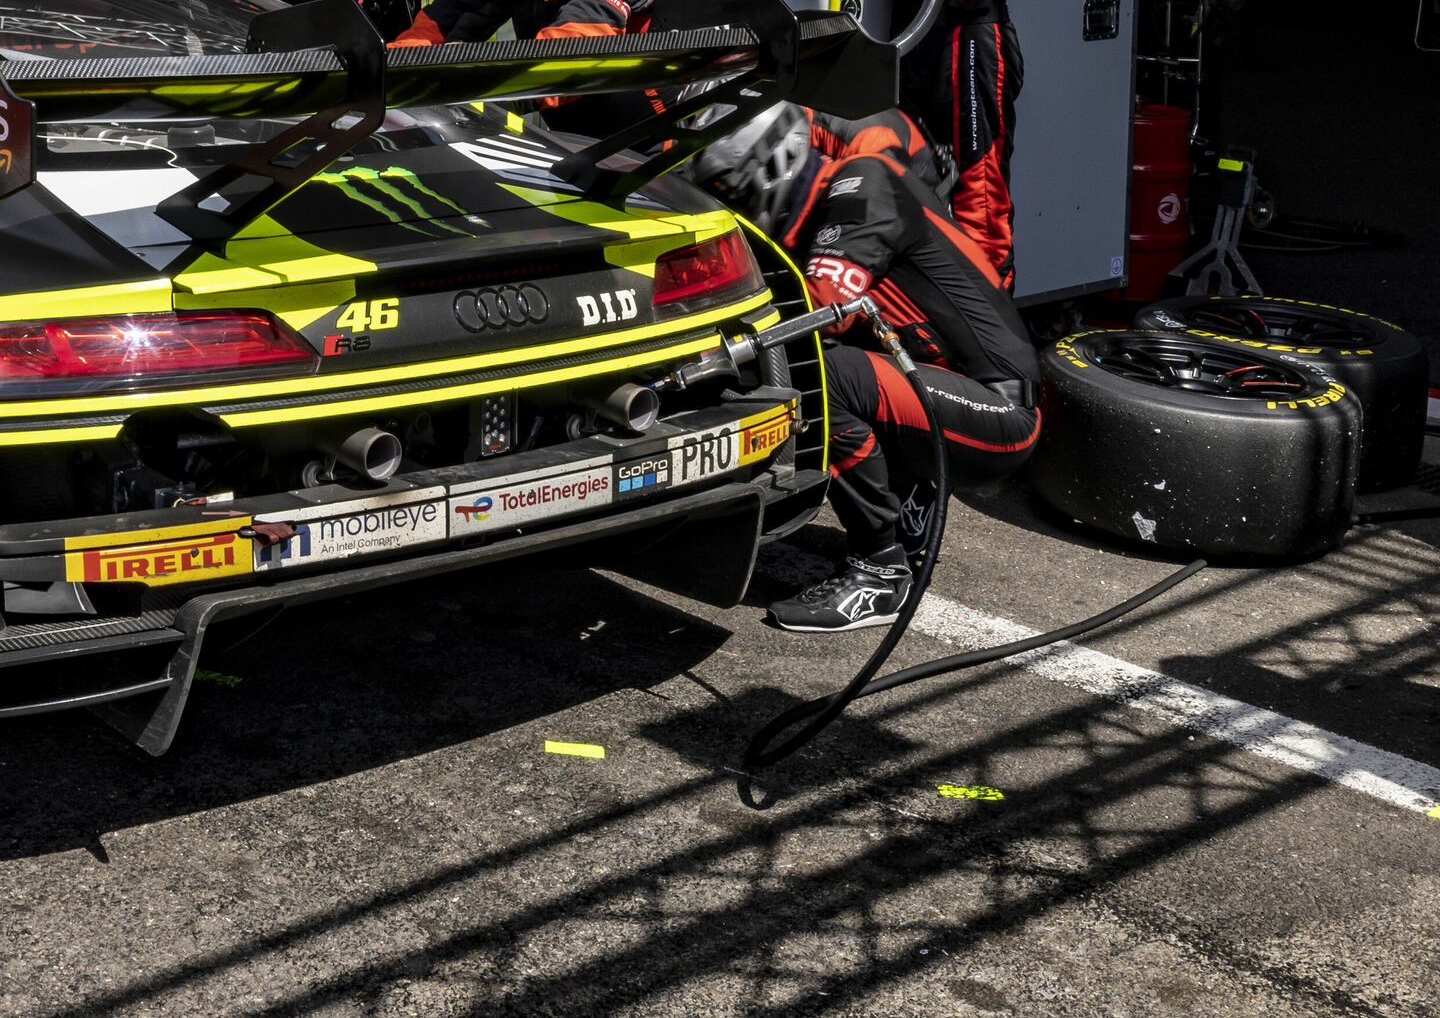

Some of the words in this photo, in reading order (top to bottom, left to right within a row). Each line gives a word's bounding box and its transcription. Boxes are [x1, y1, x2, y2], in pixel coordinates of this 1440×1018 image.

[970, 39, 979, 151] w-racingteam.com
[336, 298, 400, 332] 46
[577, 289, 638, 327] D.I.D
[334, 336, 371, 353] R8
[1267, 382, 1346, 410] PIRELLI
[681, 427, 731, 481] PRO
[744, 415, 790, 456] PRELL
[619, 457, 667, 480] GoPro
[500, 475, 608, 512] TotalEnergies
[320, 503, 438, 541] mobileye
[83, 533, 236, 582] PIRELLI
[321, 543, 334, 554] An
[336, 540, 356, 553] Intel
[358, 533, 401, 551] Company
